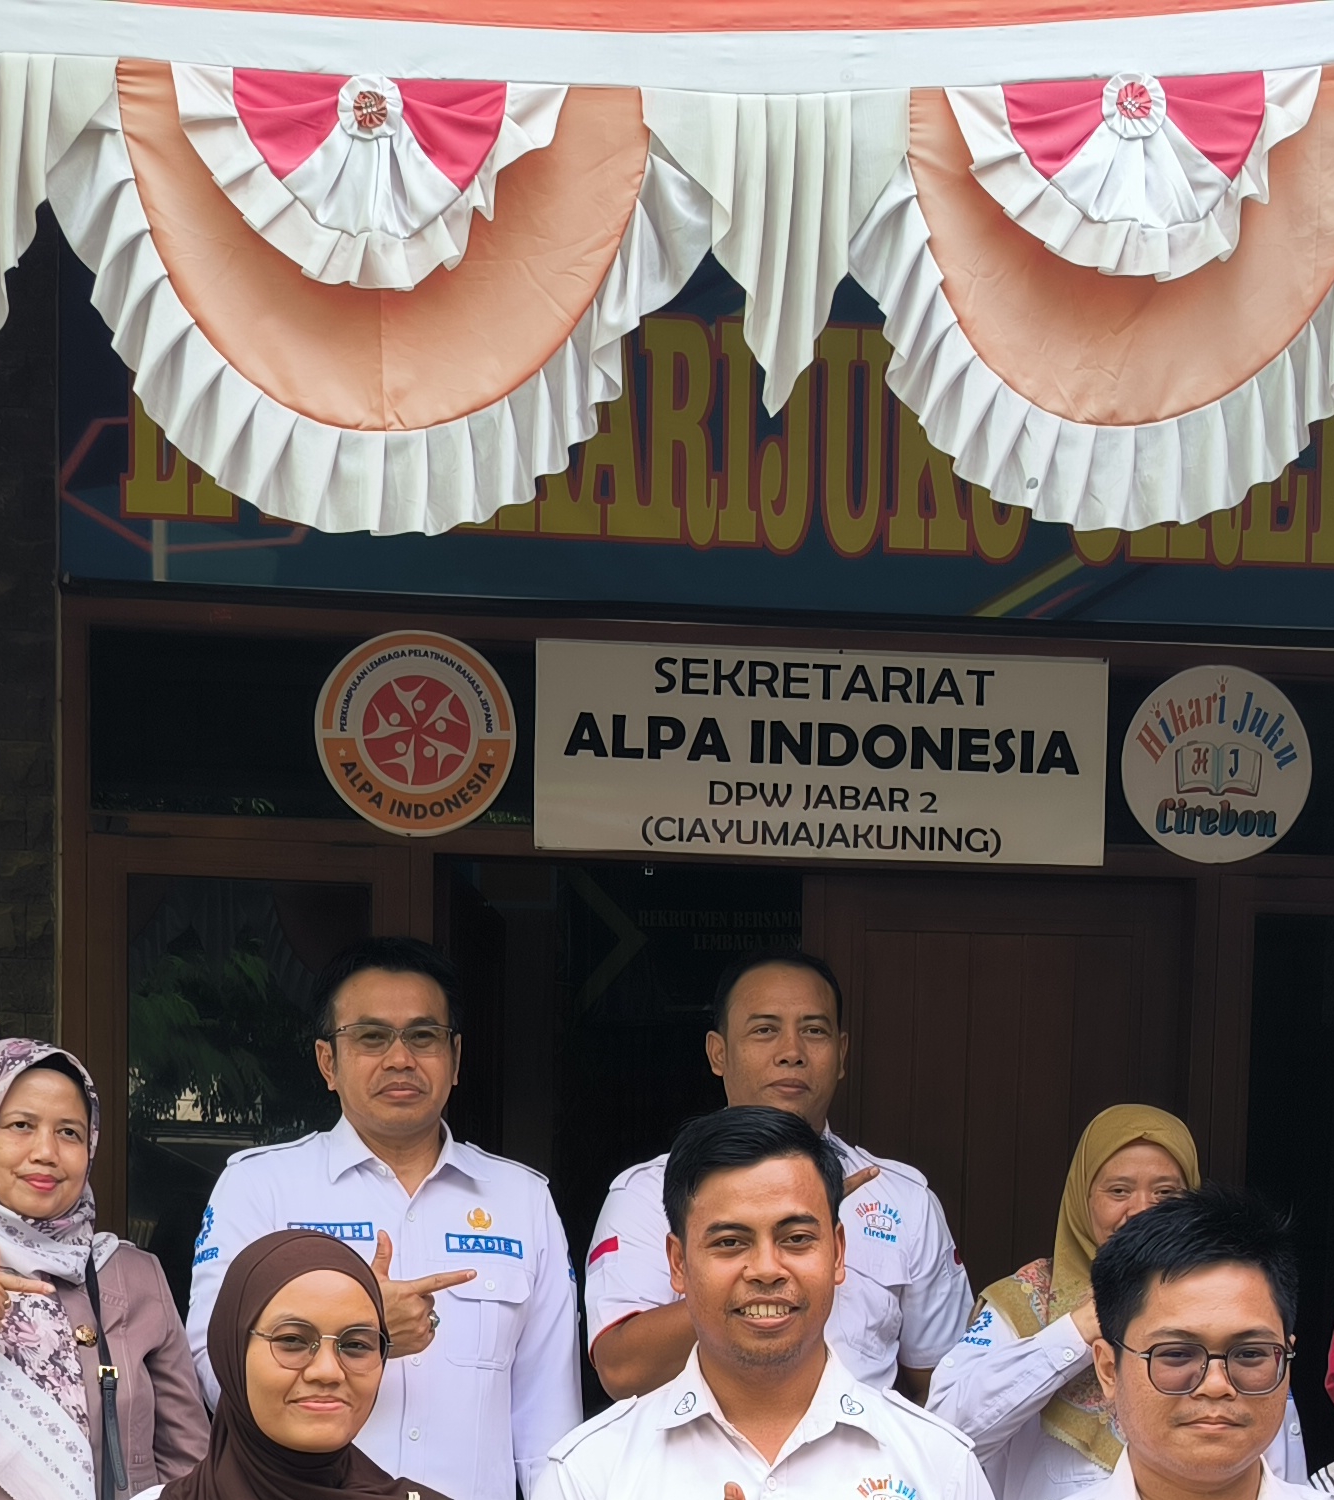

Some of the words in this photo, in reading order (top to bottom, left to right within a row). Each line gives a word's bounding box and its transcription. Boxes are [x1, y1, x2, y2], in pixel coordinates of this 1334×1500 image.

[366, 650, 408, 674] LEMBAGA
[407, 649, 458, 669] PELATIHAN
[454, 664, 484, 699] BAHASA
[478, 697, 494, 734] JEPANG
[654, 656, 995, 706] SEKRETARIAT
[563, 711, 731, 763] ALPA
[749, 719, 1080, 776] INDONESIA
[1135, 675, 1229, 765] Hikari
[1232, 691, 1299, 771] Juku
[1191, 747, 1210, 776] H
[339, 761, 385, 809] ALPA
[388, 761, 496, 820] INDONESIA
[707, 780, 794, 808] DPW
[802, 783, 911, 814] JABAR
[920, 791, 939, 815] 2
[641, 816, 1003, 858] (CIAYUMAJAKUNING)
[1155, 798, 1277, 838] Cirebon
